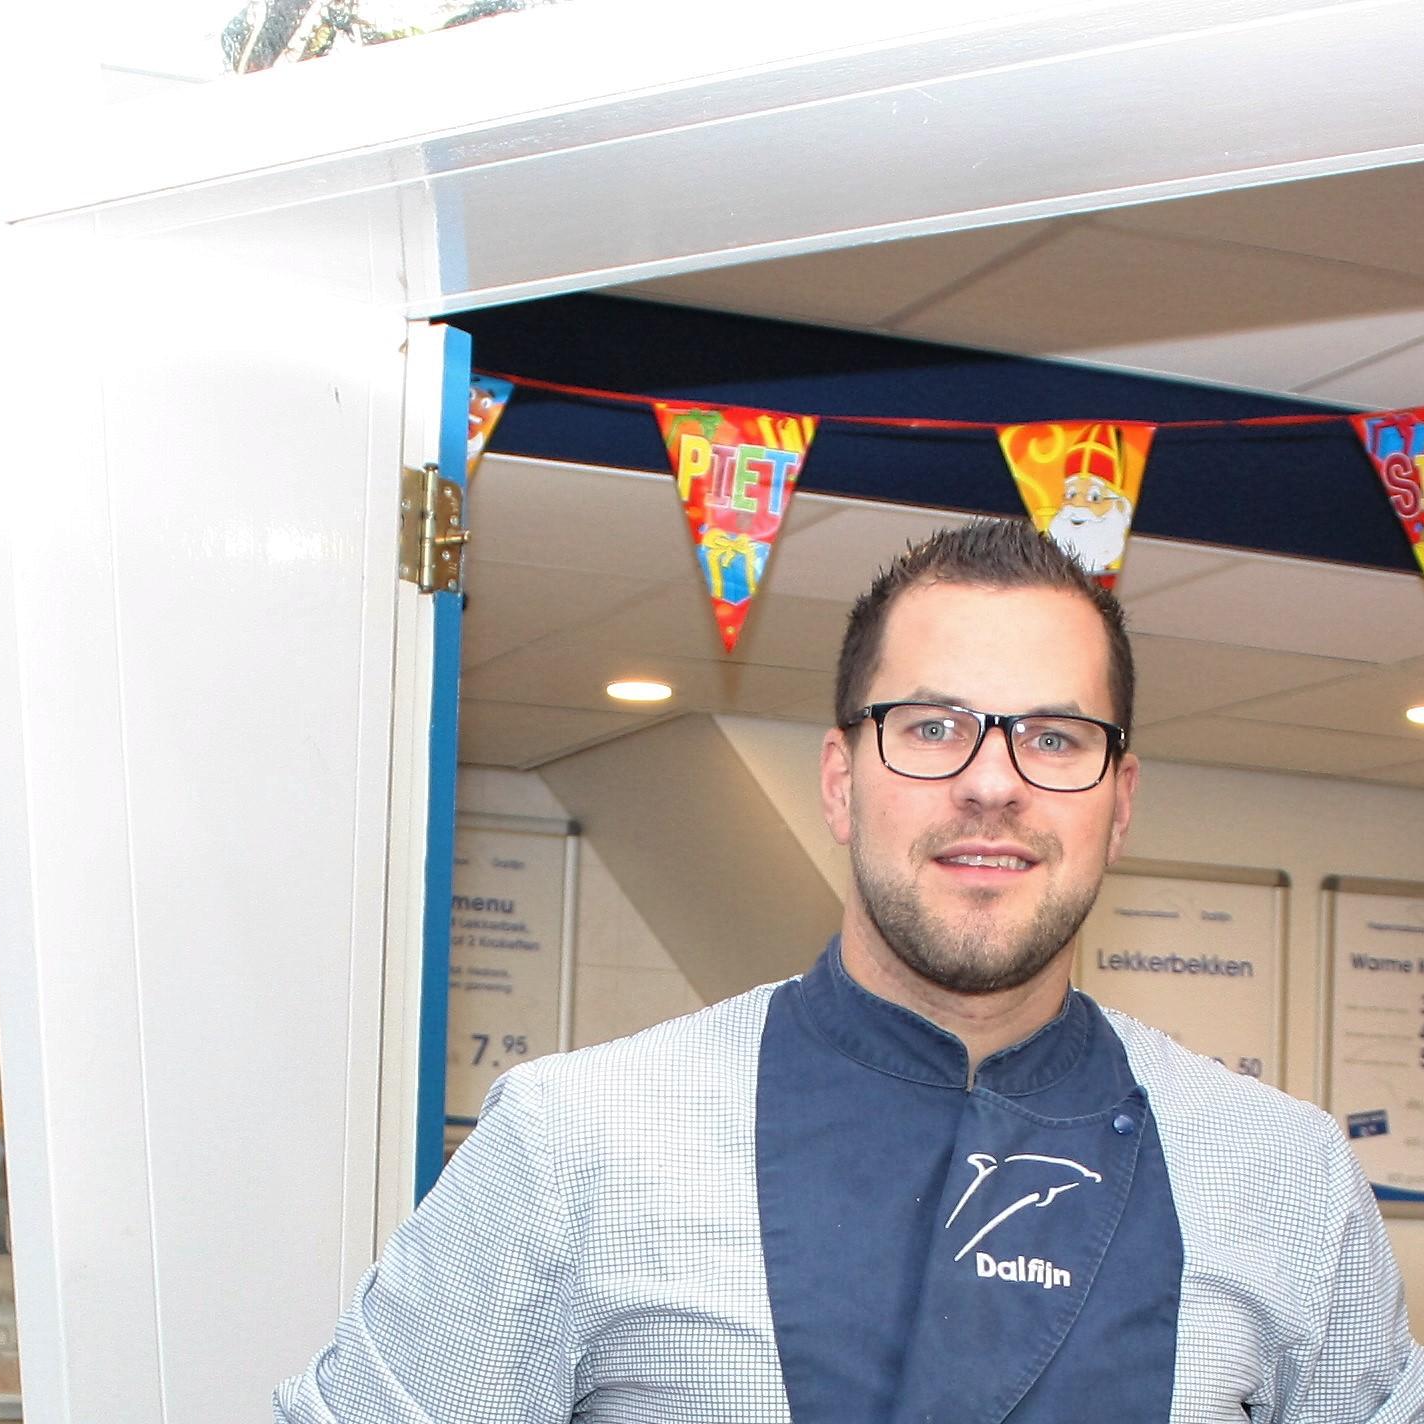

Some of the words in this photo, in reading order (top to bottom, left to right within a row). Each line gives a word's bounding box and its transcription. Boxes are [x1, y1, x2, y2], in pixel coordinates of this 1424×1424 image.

[677, 429, 802, 516] PIET
[1096, 947, 1254, 977] Lekkerbekken
[1350, 951, 1413, 973] Warme
[975, 1251, 1072, 1290] Dalfijn
